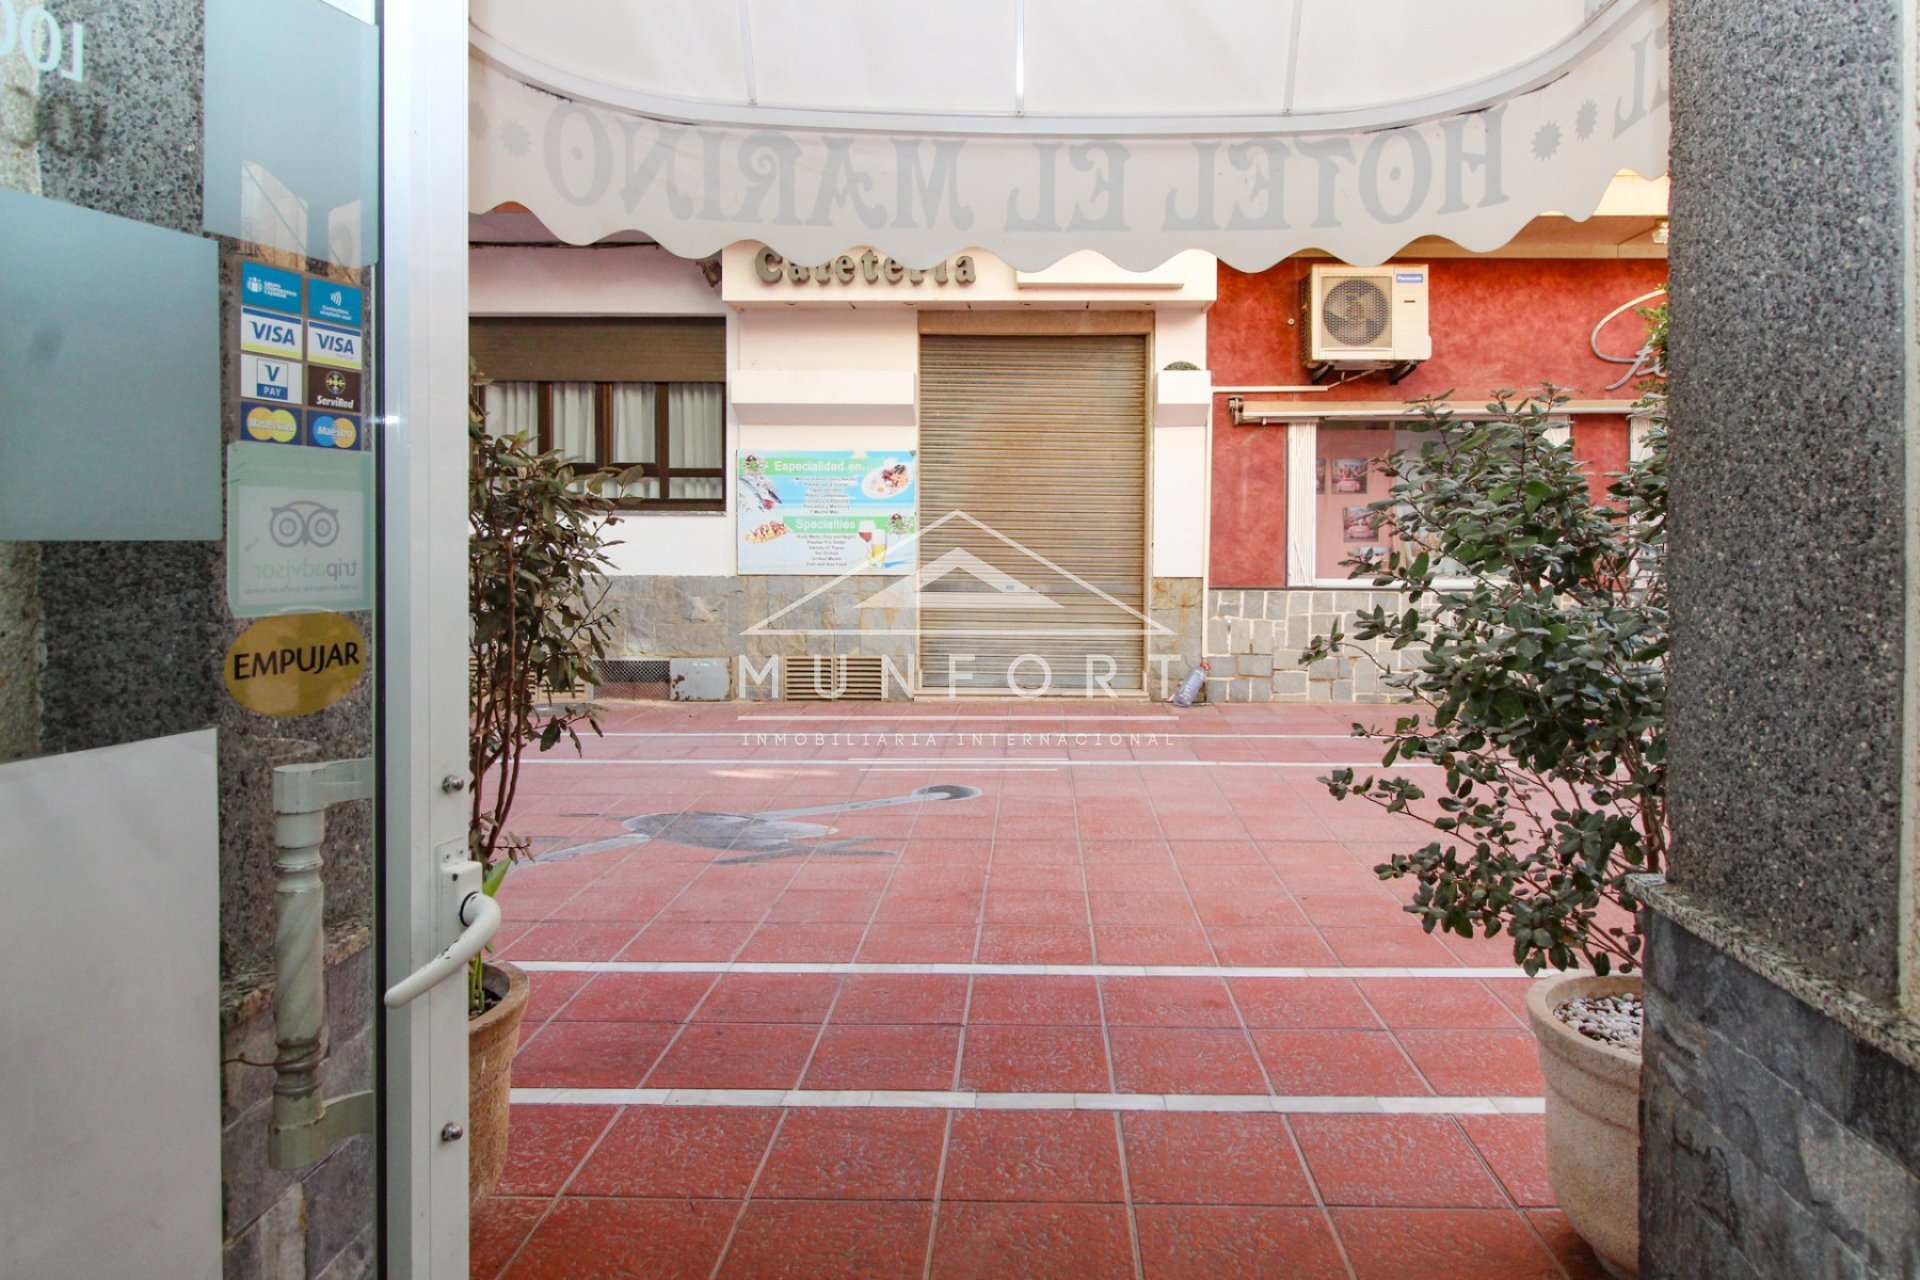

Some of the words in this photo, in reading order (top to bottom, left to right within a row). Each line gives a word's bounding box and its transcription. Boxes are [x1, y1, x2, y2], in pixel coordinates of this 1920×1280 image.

[250, 320, 296, 346] VISA
[316, 332, 355, 355] VISA
[264, 364, 280, 382] V
[263, 385, 282, 397] PAY
[316, 394, 355, 410] ServiRed
[774, 460, 844, 473] Especialidad
[796, 519, 856, 531] Specialties
[233, 641, 360, 680] EMPUJAR
